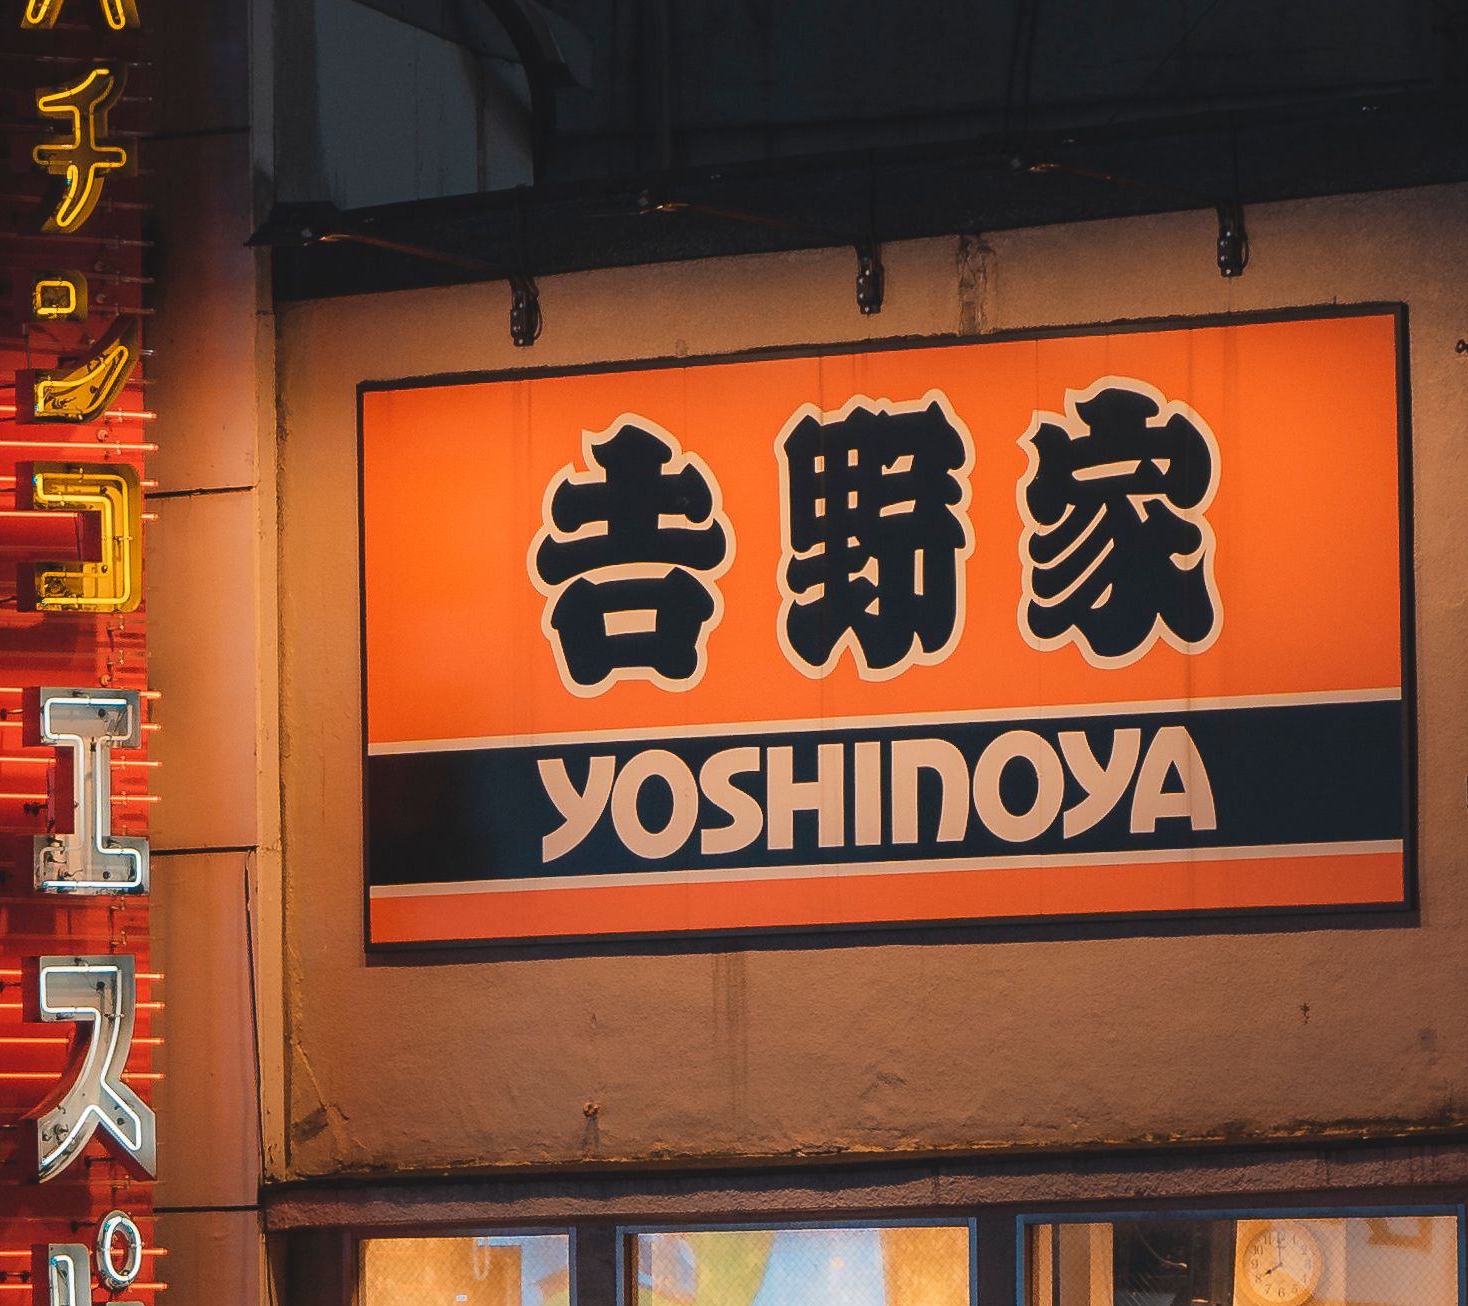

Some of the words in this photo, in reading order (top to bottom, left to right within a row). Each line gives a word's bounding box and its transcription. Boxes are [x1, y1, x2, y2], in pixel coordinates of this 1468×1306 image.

[22, 0, 142, 612] チンコ
[538, 726, 1217, 862] YOSHINOYA
